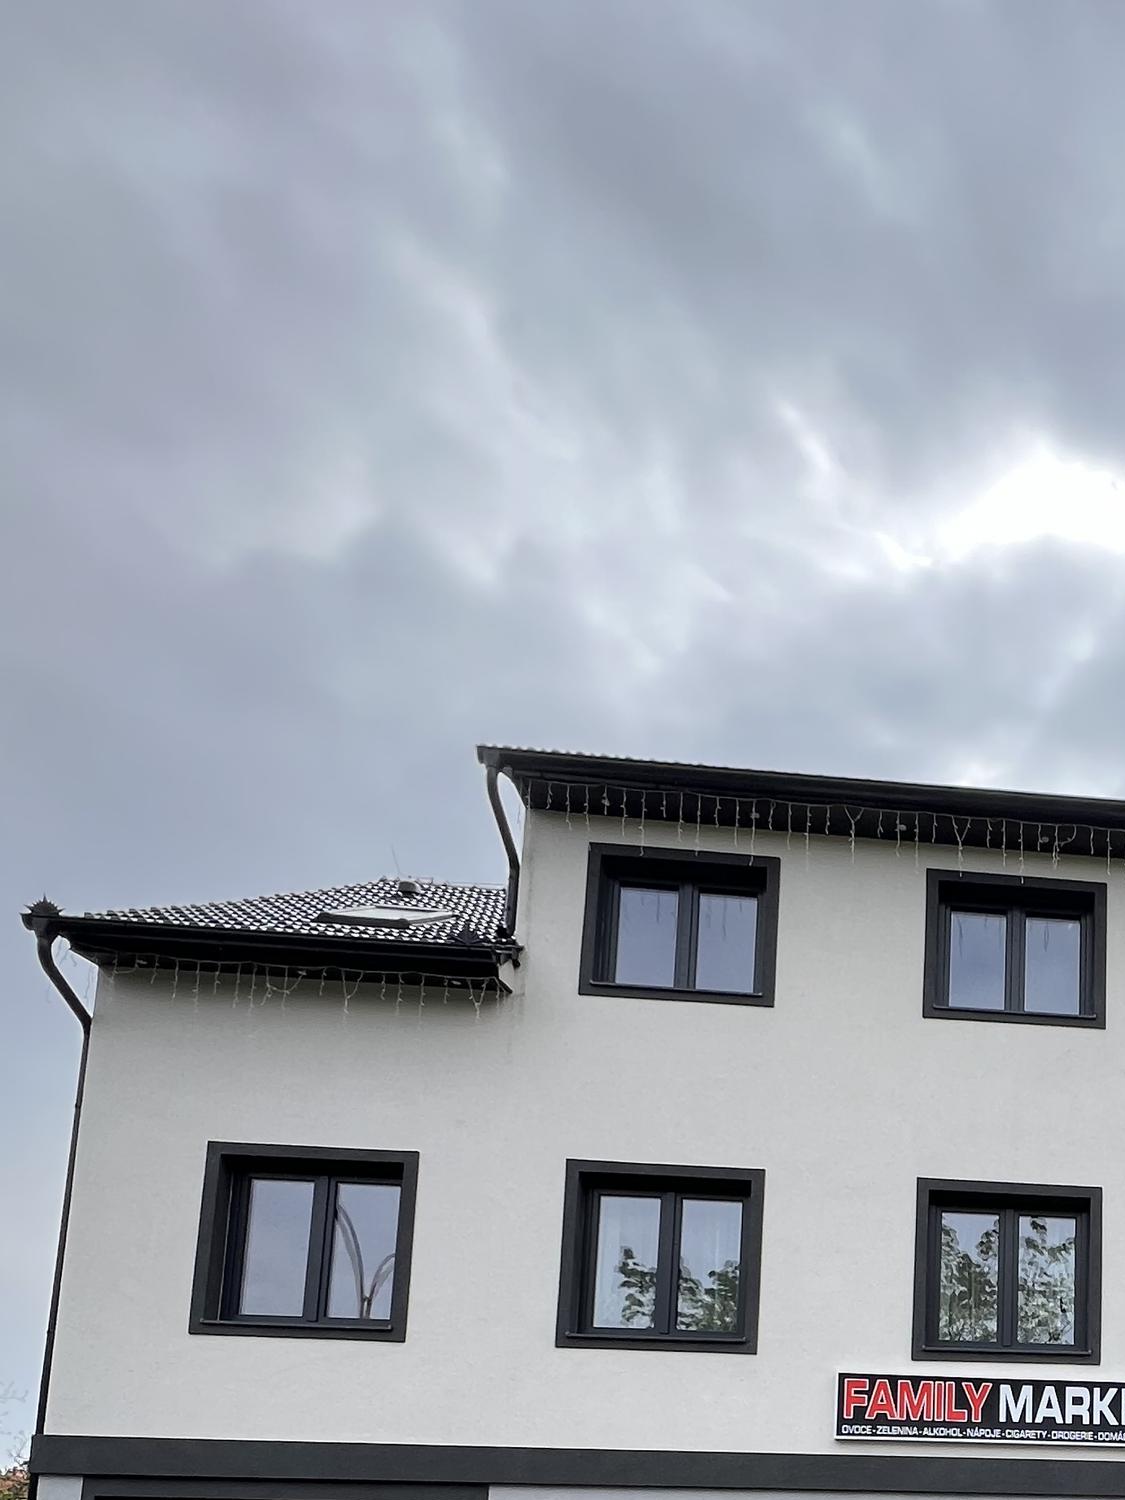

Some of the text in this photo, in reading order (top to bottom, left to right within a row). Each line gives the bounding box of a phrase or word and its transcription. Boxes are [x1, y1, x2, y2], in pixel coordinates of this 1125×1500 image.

[844, 1378, 992, 1422] FAMILY
[841, 1424, 873, 1434] OVOCE
[876, 1425, 918, 1435] ZELENINA
[922, 1426, 963, 1437] ALKOHOL
[966, 1426, 1001, 1438] NÁPOJE
[1005, 1429, 1047, 1439] CIGARETY
[1051, 1430, 1094, 1441] DROGERIE
